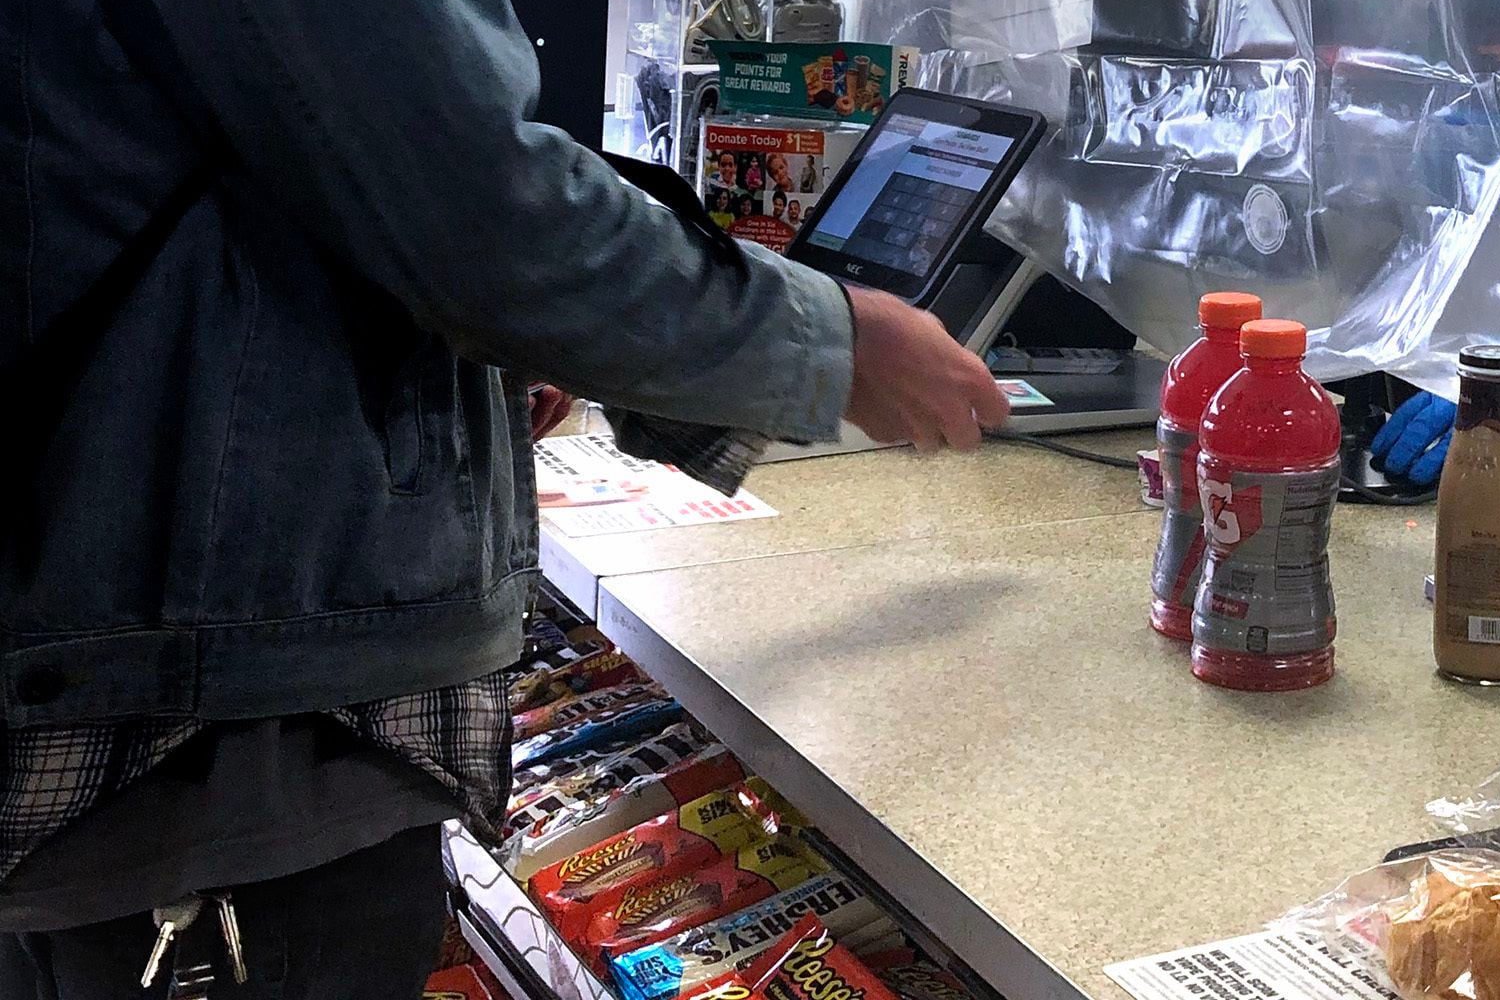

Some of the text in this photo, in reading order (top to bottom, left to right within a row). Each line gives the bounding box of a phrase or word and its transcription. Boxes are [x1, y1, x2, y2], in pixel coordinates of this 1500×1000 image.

[766, 53, 788, 64] YOUR
[735, 63, 782, 78] POINTS FOR
[725, 76, 791, 93] GREAT REWARDS
[709, 132, 748, 145] Donate
[750, 134, 782, 148] Today
[786, 132, 800, 152] $1
[1156, 960, 1177, 971] NO
[1174, 956, 1204, 976] VAPE
[1209, 949, 1231, 961] WE
[1225, 961, 1251, 979] WILL
[1191, 953, 1253, 996] COMPLETING
